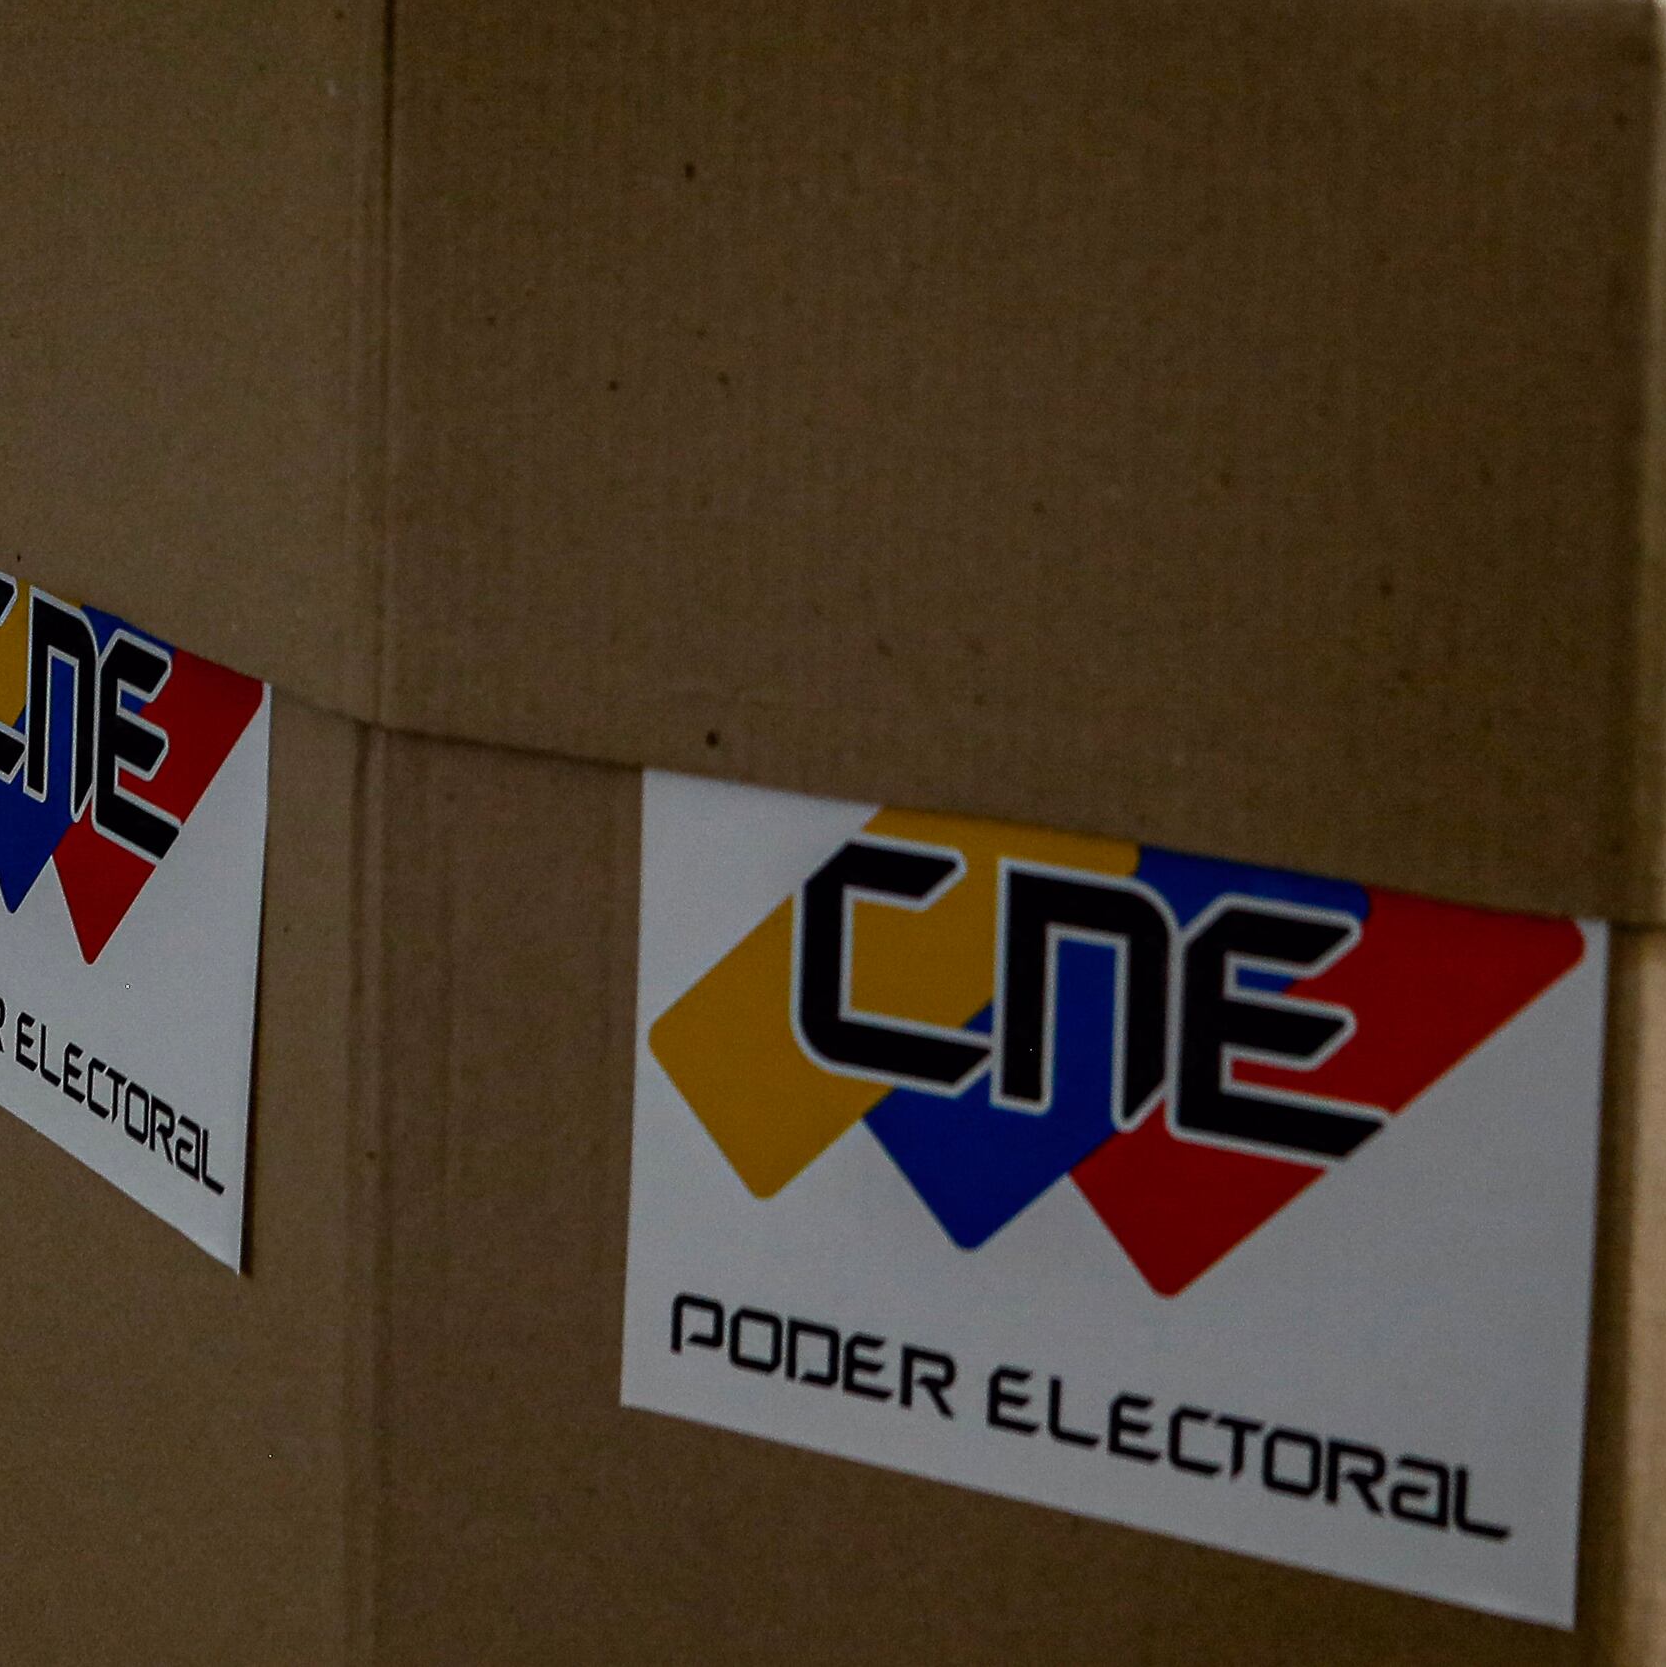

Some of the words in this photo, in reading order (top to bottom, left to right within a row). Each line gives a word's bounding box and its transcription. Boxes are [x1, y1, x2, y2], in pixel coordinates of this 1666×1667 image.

[15, 1012, 226, 1196] ELECTORAL
[791, 834, 1390, 1167] CNE
[670, 1291, 958, 1420] PODER
[986, 1365, 1513, 1541] ELECTORAL
